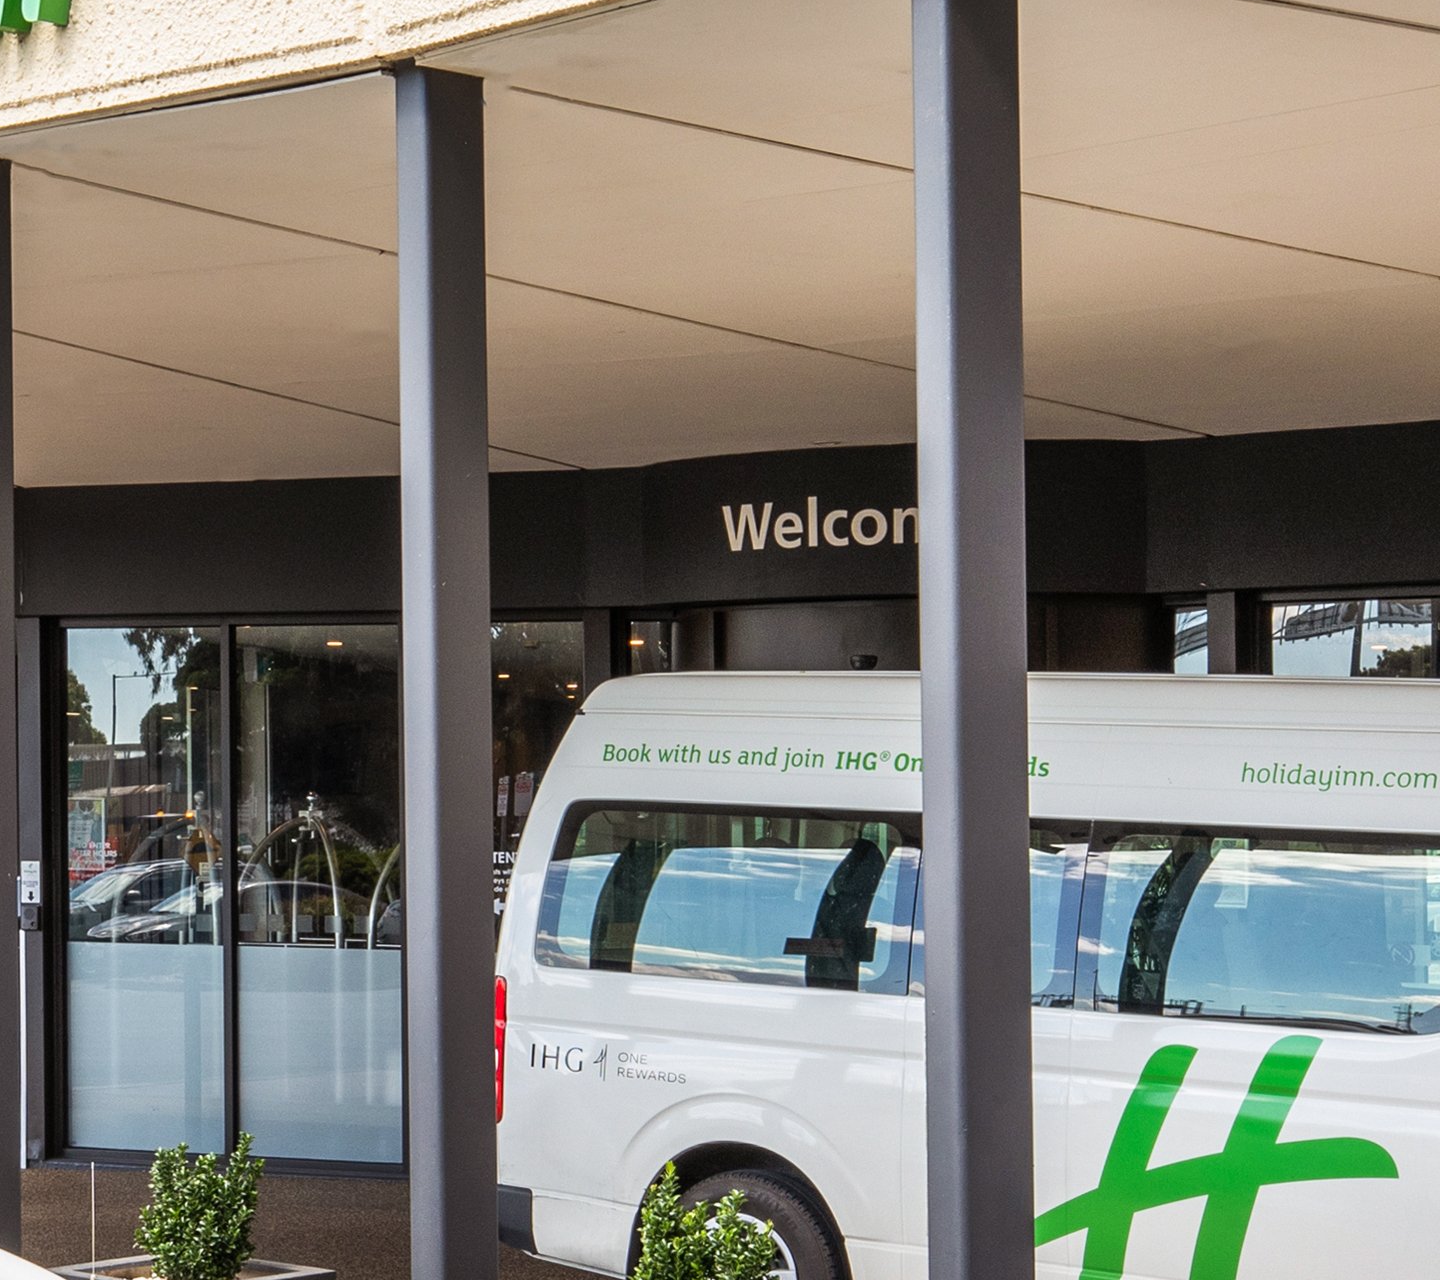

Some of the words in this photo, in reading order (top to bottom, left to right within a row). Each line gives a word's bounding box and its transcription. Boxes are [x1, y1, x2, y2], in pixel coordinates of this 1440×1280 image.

[722, 496, 918, 551] Welcom
[602, 743, 652, 762] Book
[657, 744, 702, 763] with
[708, 749, 732, 764] us
[737, 746, 778, 767] and
[780, 747, 825, 772] join
[894, 753, 923, 772] On
[1240, 762, 1438, 792] holidayinn.com
[530, 1043, 583, 1073] IHG
[617, 1052, 648, 1065] ONE
[617, 1067, 687, 1084] REWARDS
